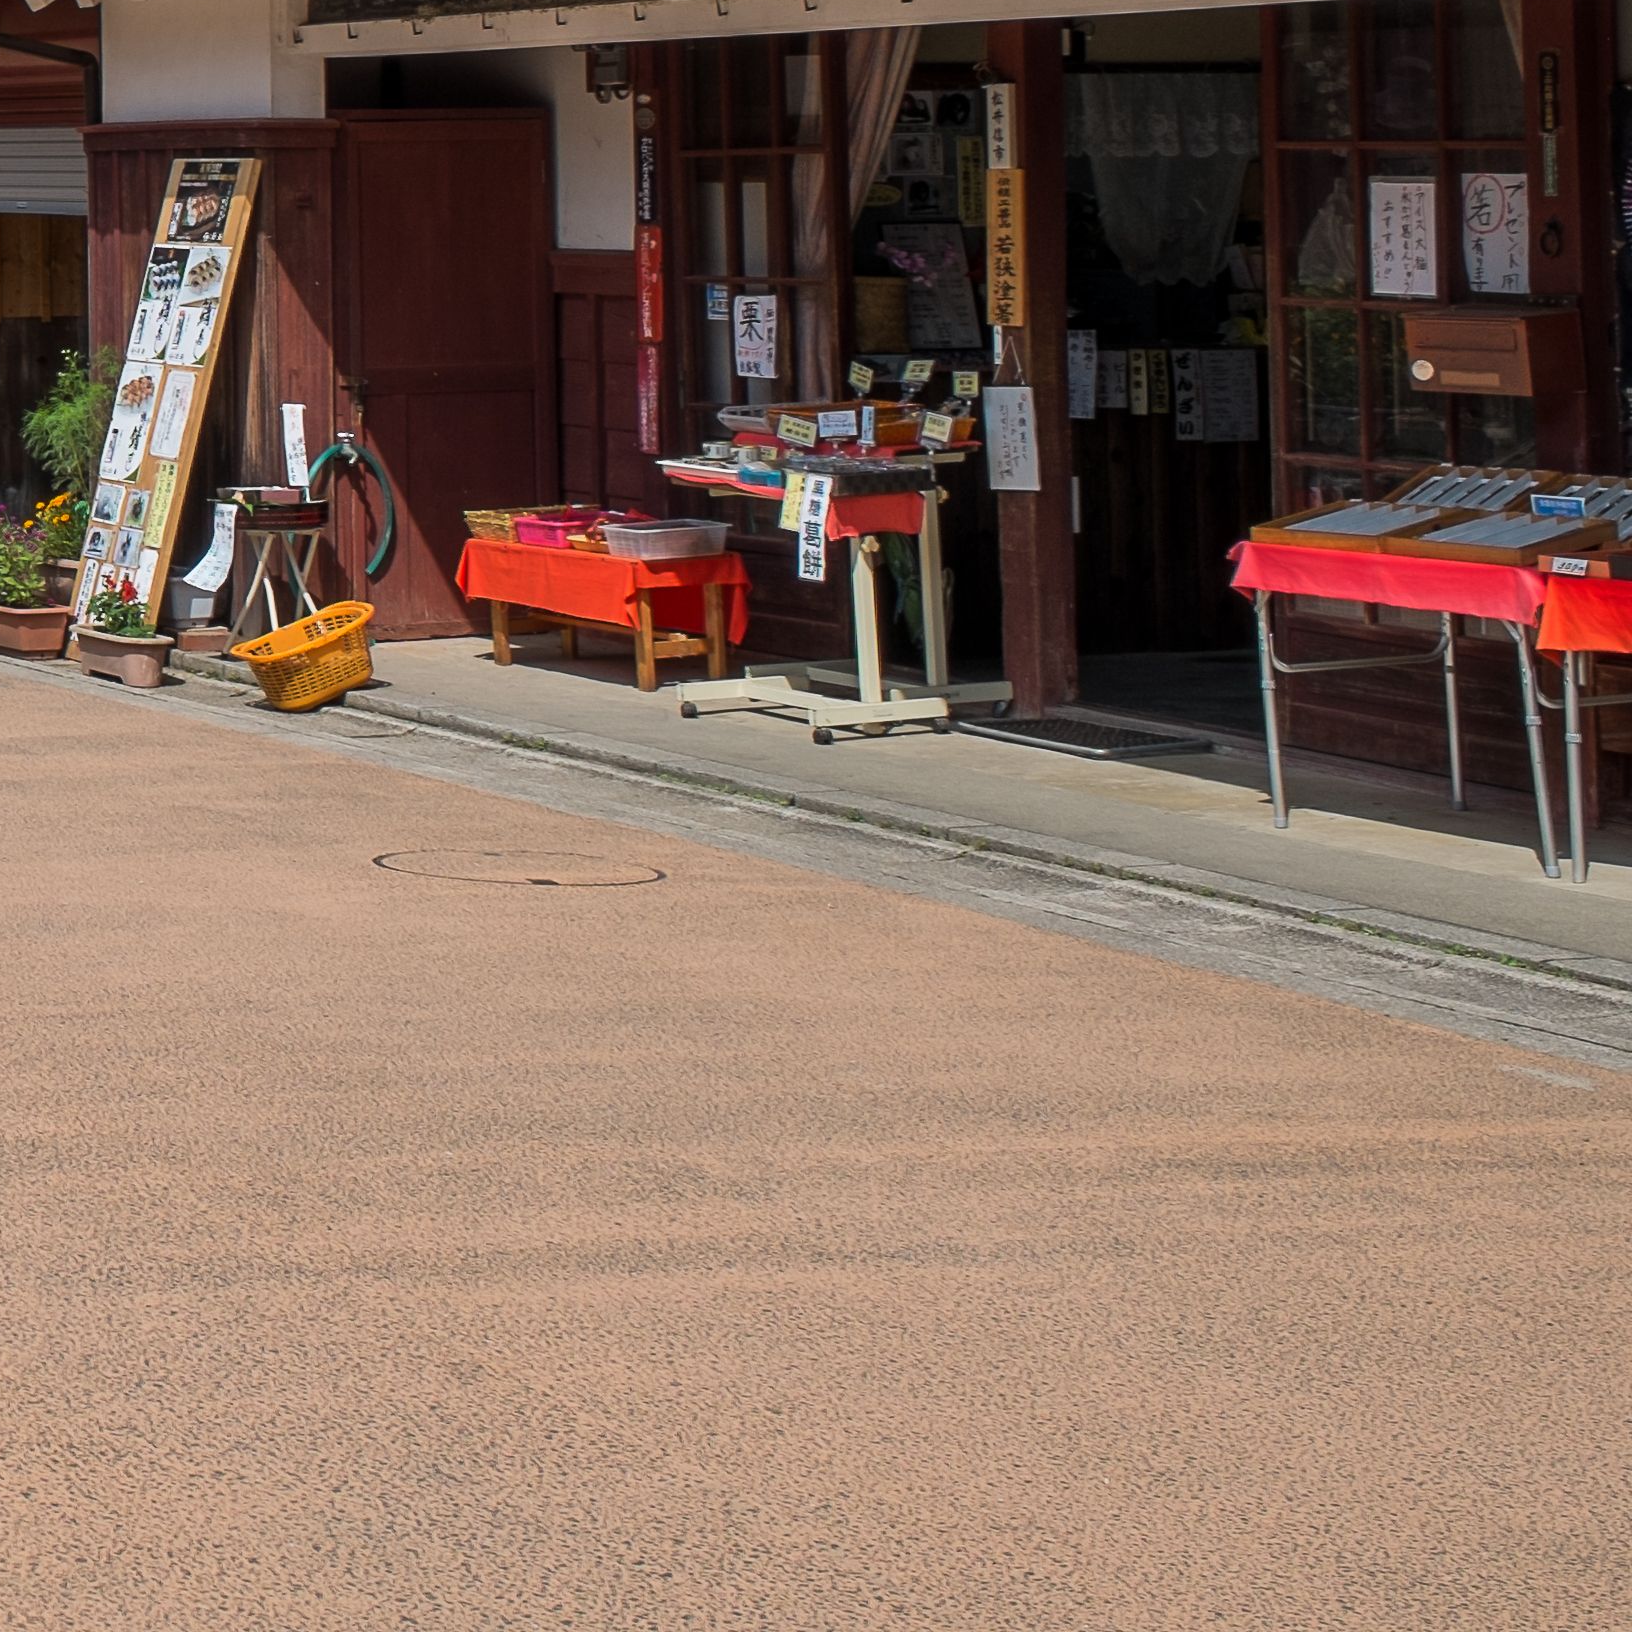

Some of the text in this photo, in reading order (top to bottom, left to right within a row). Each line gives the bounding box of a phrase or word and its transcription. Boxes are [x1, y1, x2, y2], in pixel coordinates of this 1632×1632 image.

[1502, 181, 1526, 290] プレゼント用
[1174, 351, 1194, 435] ぜんざい
